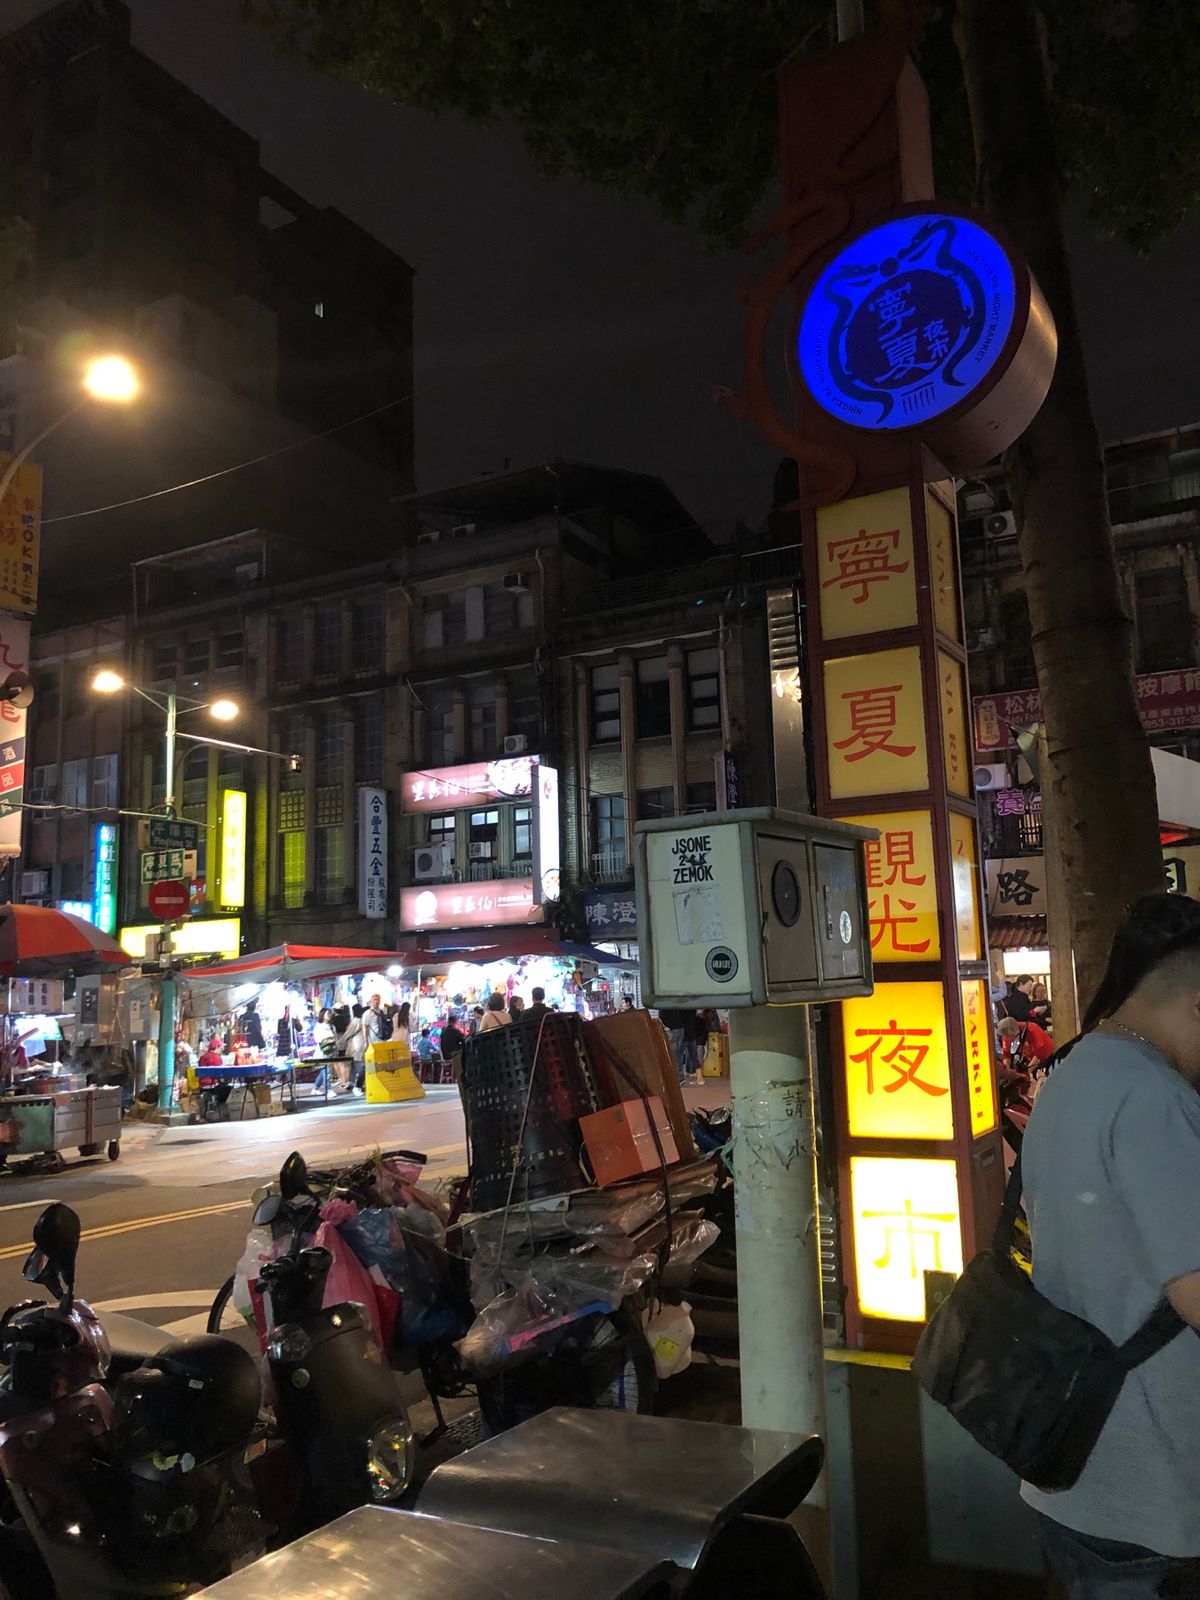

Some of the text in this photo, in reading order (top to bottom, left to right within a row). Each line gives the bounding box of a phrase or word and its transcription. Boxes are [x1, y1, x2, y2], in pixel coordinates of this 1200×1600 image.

[868, 281, 938, 384] 寧夏
[922, 318, 949, 360] 夜市
[974, 322, 998, 364] MARKET
[671, 835, 712, 855] JSONE
[672, 864, 714, 885] ZEMOK
[997, 869, 1041, 906] 路
[584, 901, 638, 926] 陳澄
